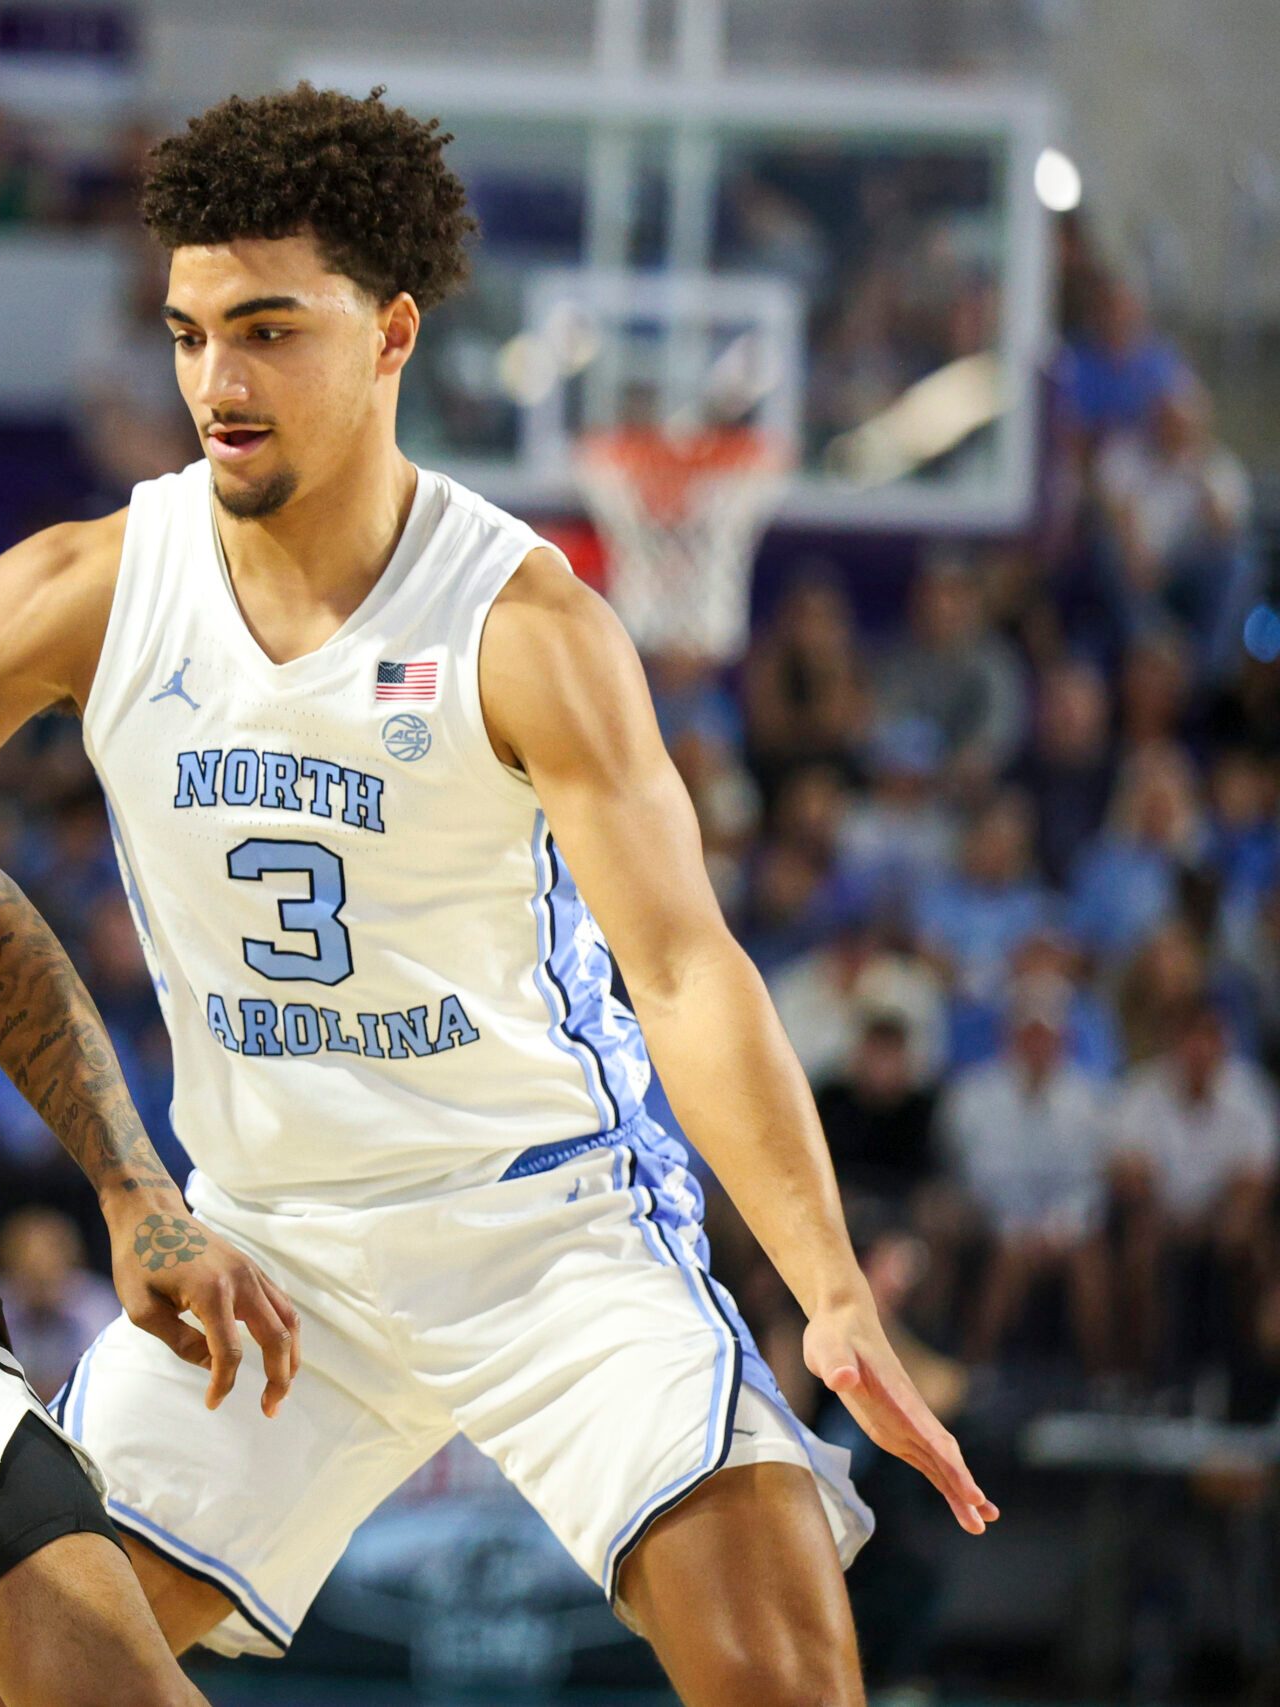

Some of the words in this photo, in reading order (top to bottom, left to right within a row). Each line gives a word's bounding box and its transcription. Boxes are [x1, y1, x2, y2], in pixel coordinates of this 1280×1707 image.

[174, 748, 385, 834] NORTH
[226, 837, 355, 986] 3
[207, 993, 481, 1060] AROLINA
